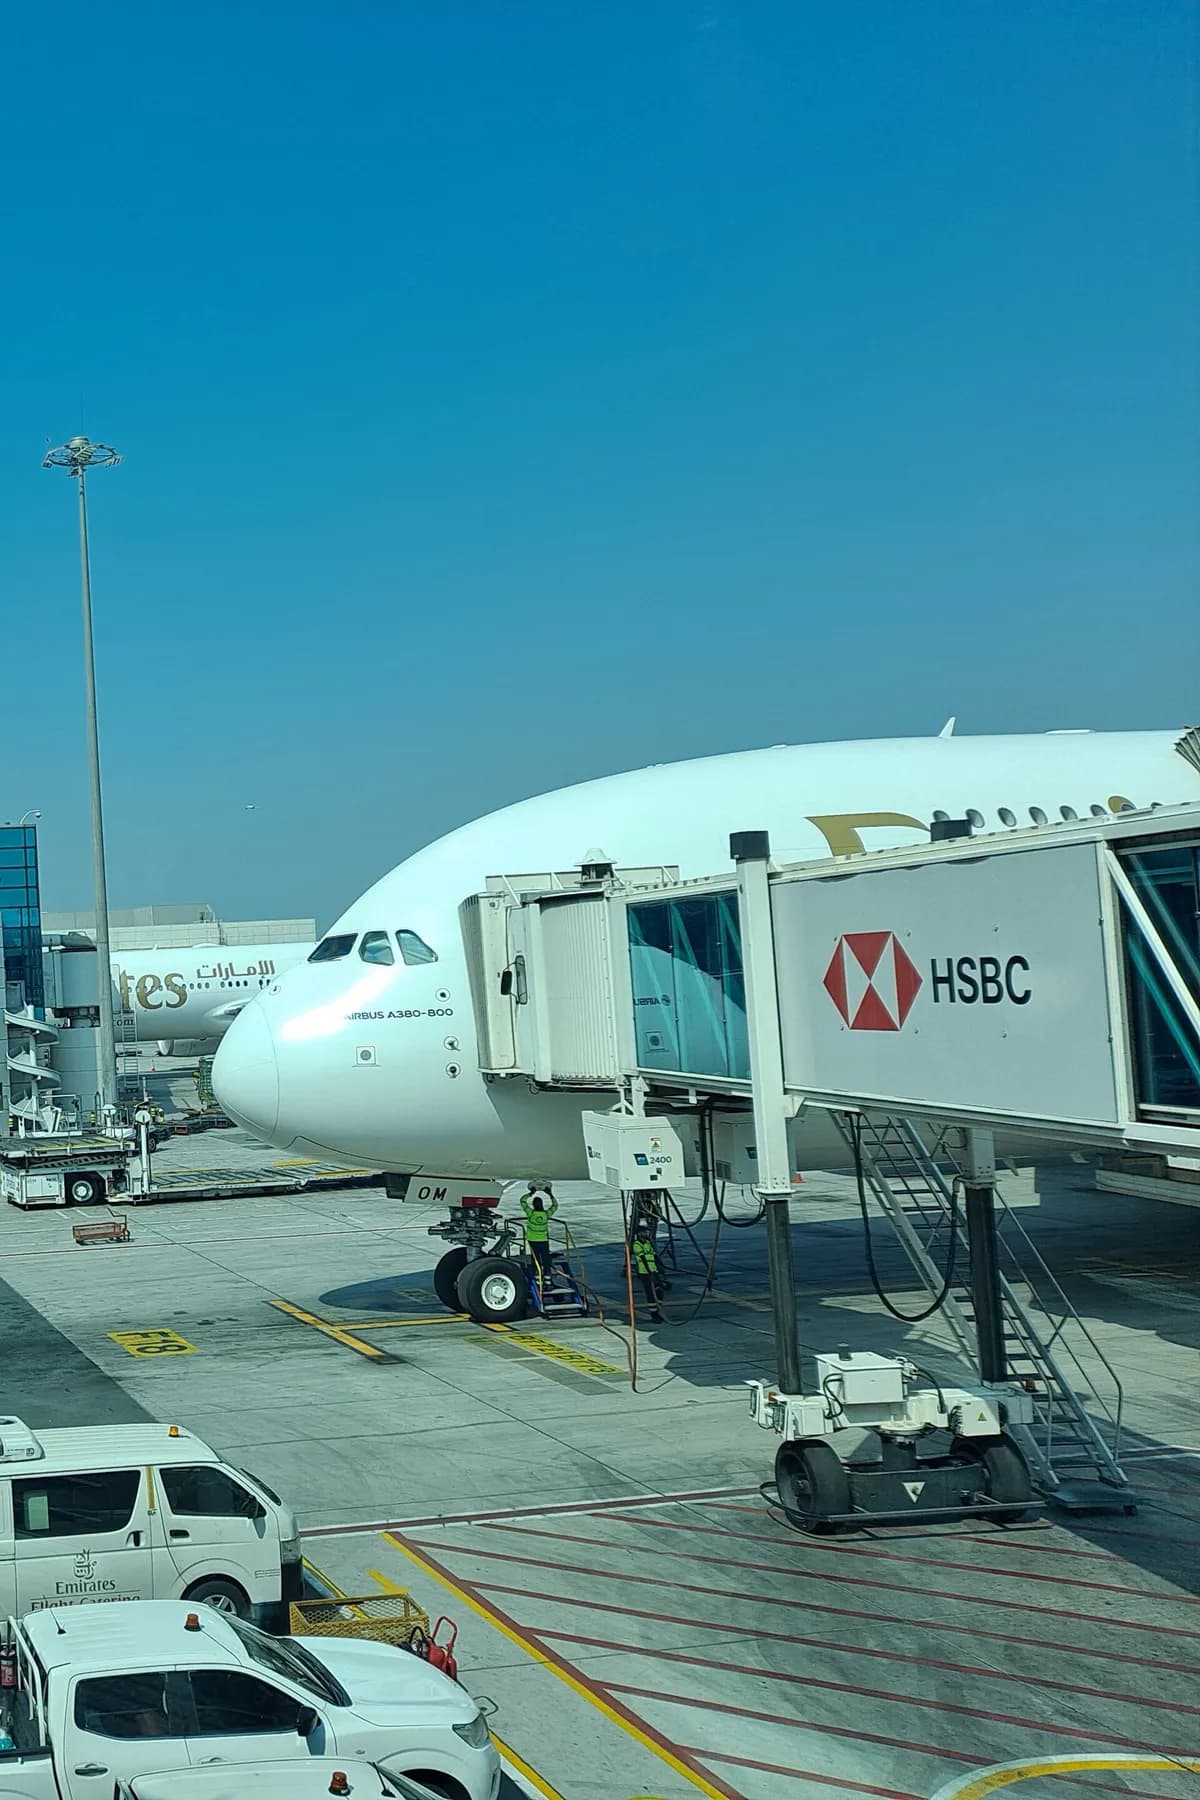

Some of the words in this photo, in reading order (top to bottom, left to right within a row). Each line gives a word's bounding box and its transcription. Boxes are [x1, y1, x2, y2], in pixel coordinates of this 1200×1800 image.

[196, 959, 275, 981] الإمارات
[930, 955, 1032, 1005] HSBC
[344, 1010, 385, 1021] AIRBUS
[387, 1007, 454, 1019] A380-800
[649, 1155, 672, 1165] 2400
[417, 1186, 448, 1201] OM
[116, 1331, 188, 1354] F18
[55, 1579, 117, 1595] Emirates
[80, 1595, 141, 1605] Cerin
